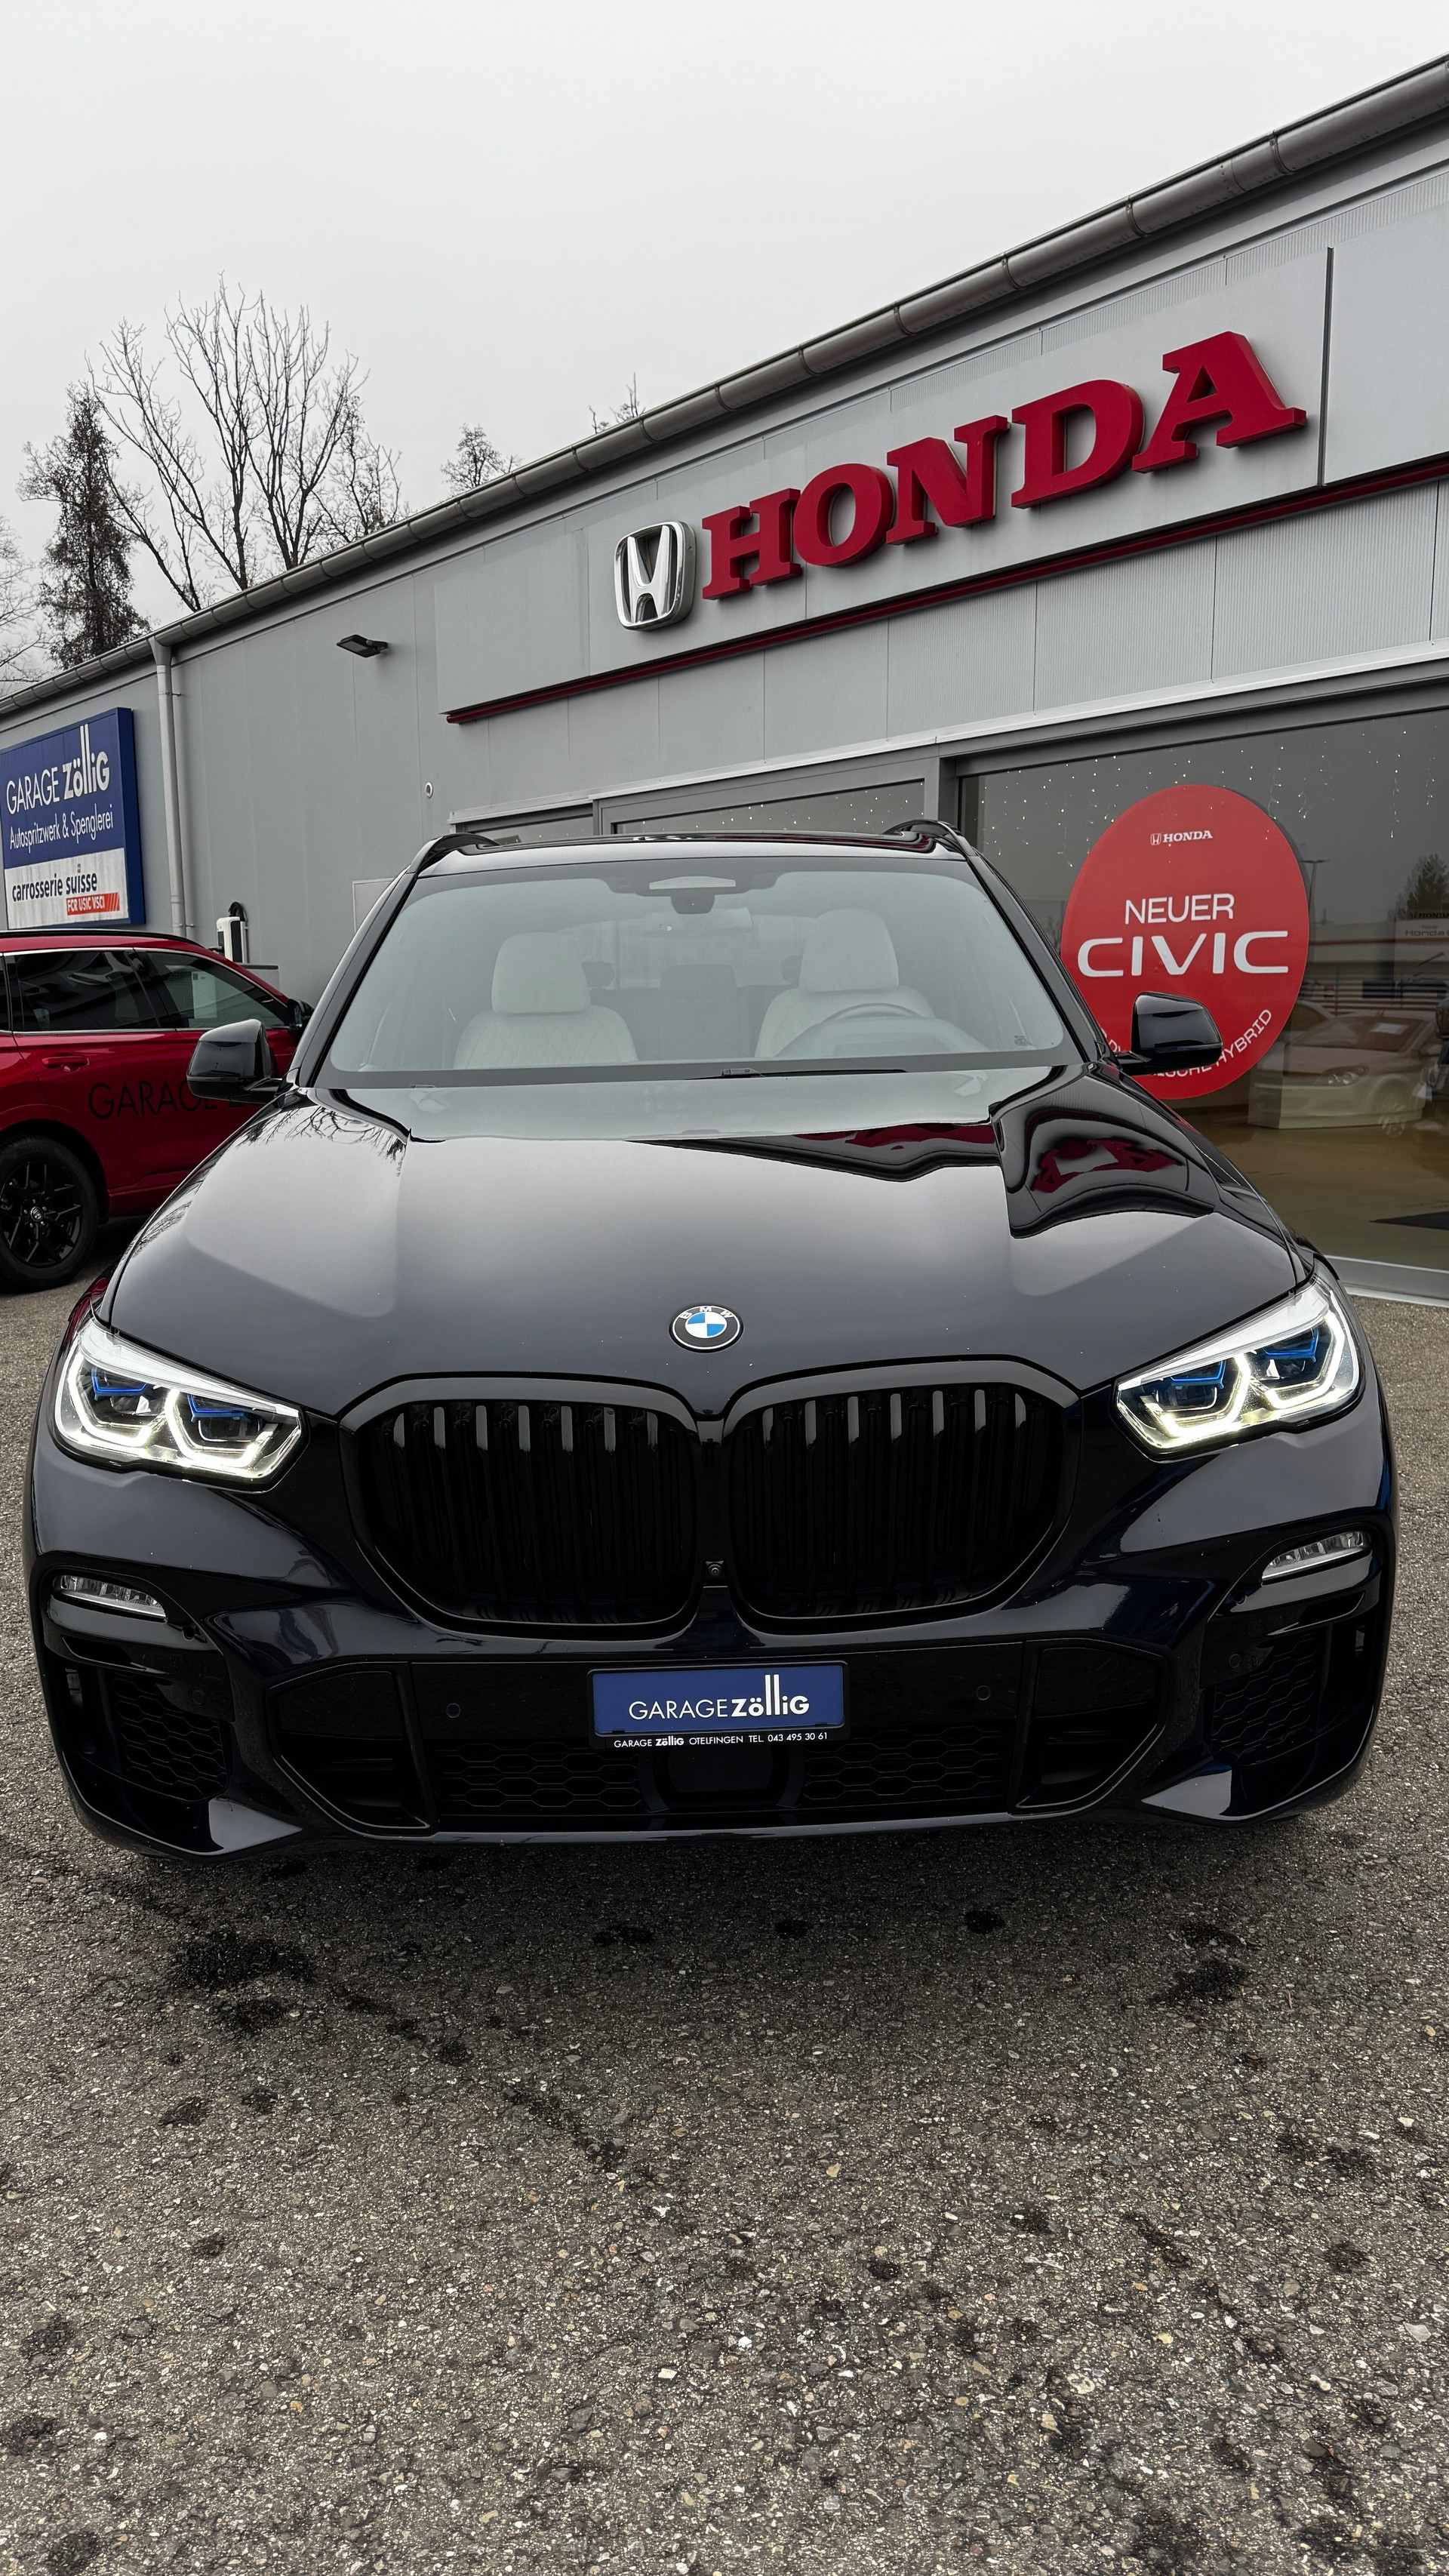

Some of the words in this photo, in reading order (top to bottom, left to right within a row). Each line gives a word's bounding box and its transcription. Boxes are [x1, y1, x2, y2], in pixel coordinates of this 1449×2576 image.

[702, 331, 1306, 601] HONDA
[6, 766, 60, 814] GARAGE
[10, 813, 61, 854] Autospritzwerk
[62, 812, 69, 839] &
[70, 803, 113, 844] Spenglerei
[1163, 830, 1213, 843] HONDA
[12, 873, 63, 902] carrosserie
[66, 871, 97, 895] suisse
[1124, 893, 1235, 925] NEUER
[1078, 930, 1289, 978] CIVIC
[629, 1699, 728, 1720] GARAGE
[614, 1739, 653, 1748] GARAGE
[689, 1735, 743, 1745] OTELFINGEN
[748, 1734, 764, 1743] TEL.
[768, 1734, 783, 1742] 043
[786, 1733, 802, 1741] 495
[804, 1732, 816, 1740] 30
[817, 1731, 828, 1740] 61
